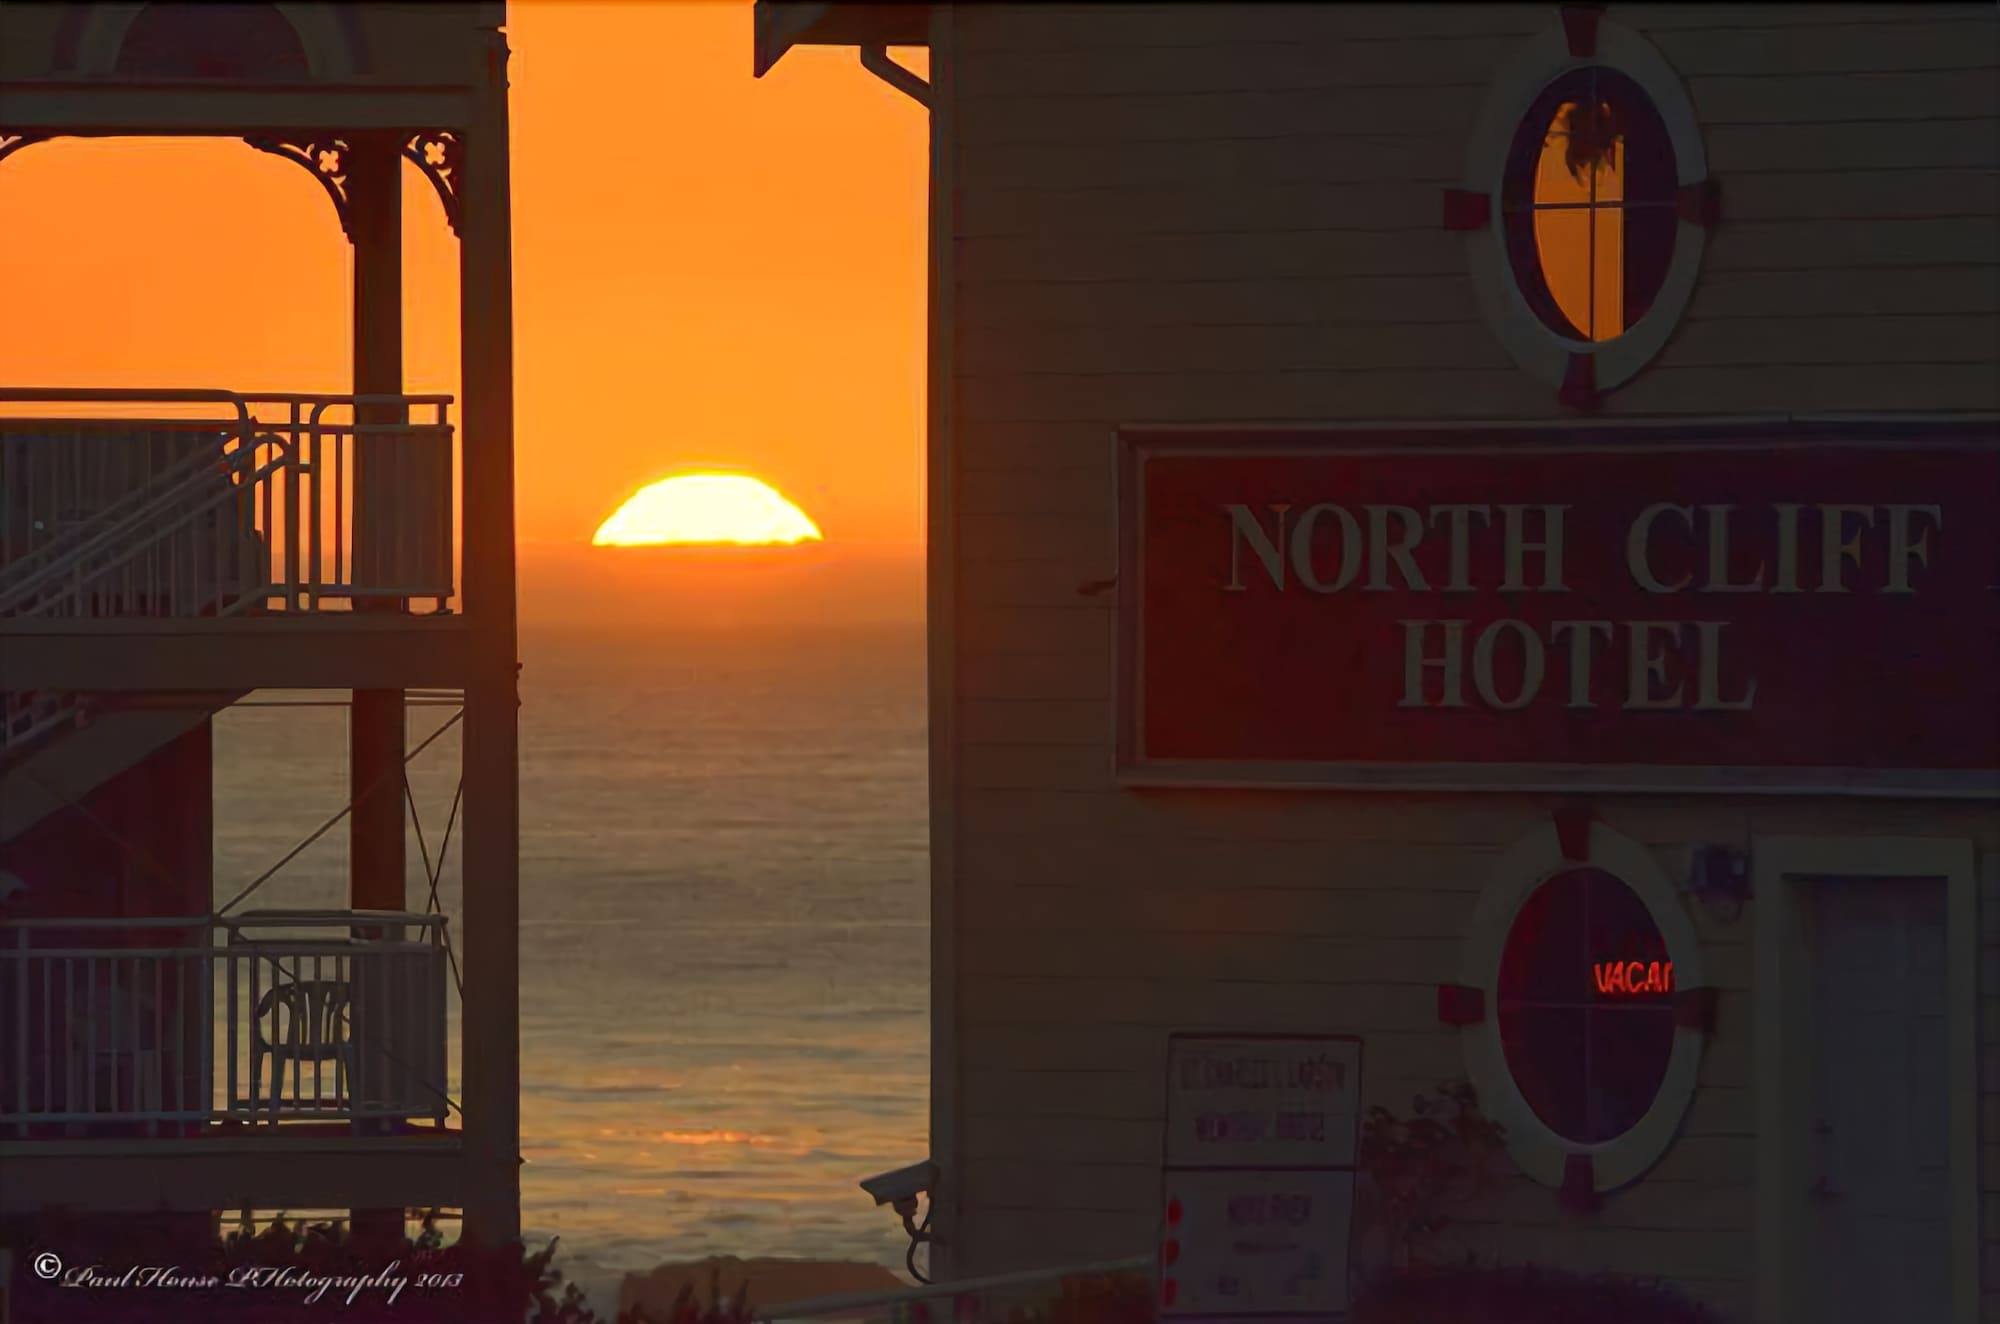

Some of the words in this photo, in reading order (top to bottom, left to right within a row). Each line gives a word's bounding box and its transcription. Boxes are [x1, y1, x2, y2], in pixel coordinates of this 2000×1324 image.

[1222, 501, 1574, 595] NORTH
[1625, 500, 1943, 595] CLIFF
[1397, 617, 1759, 712] HOTEL
